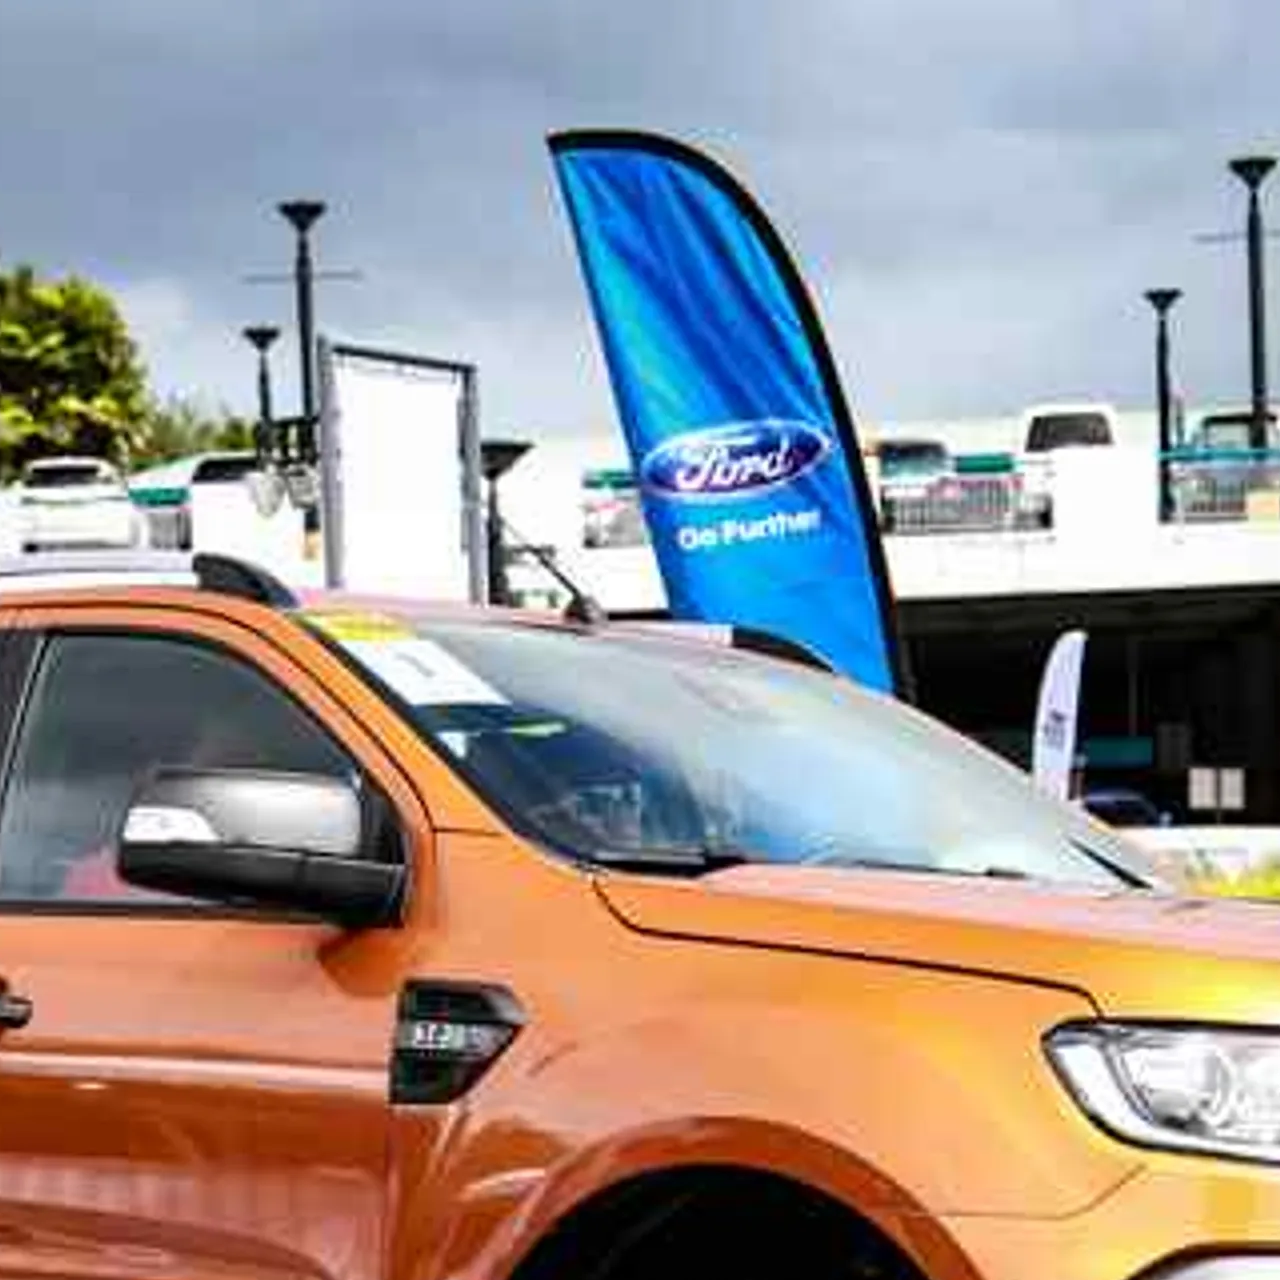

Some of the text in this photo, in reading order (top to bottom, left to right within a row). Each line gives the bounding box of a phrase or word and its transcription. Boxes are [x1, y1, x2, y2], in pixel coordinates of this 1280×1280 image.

[675, 431, 795, 491] Ford
[677, 510, 820, 550] Go Further
